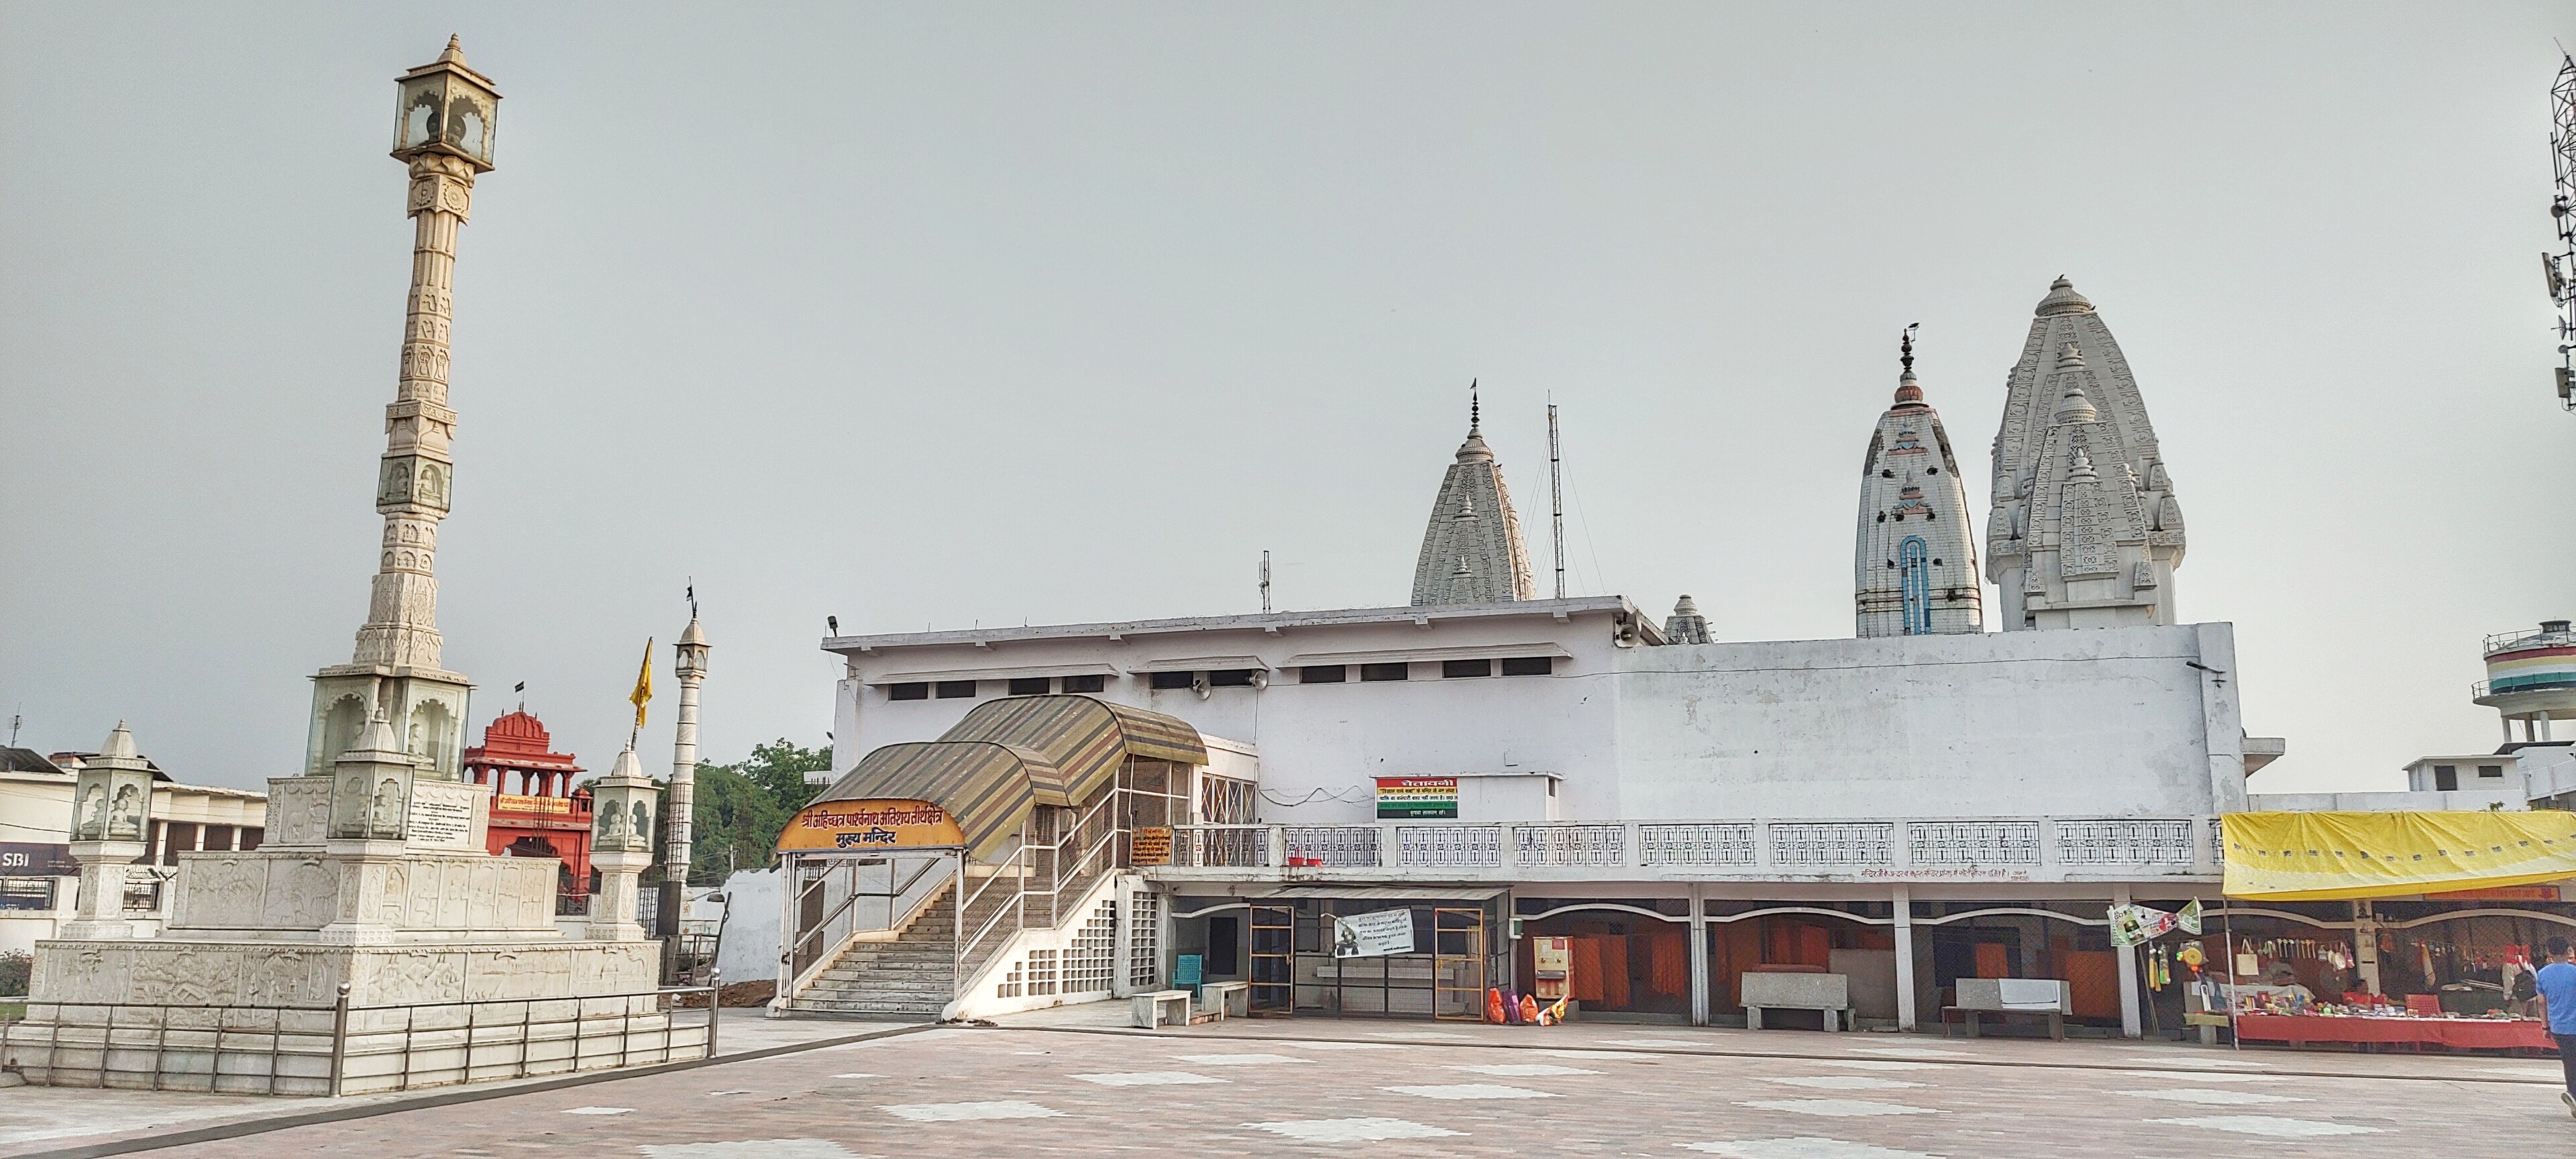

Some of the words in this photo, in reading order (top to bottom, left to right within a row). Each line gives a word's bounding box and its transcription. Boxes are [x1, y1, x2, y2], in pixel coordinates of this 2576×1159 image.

[802, 810, 812, 828] श्री
[813, 810, 845, 829] अहिच्छत्र
[880, 808, 911, 826] अतिशय
[837, 833, 861, 848] मुख्य
[863, 827, 896, 844] मन्दिर
[2, 852, 30, 867] SBI
